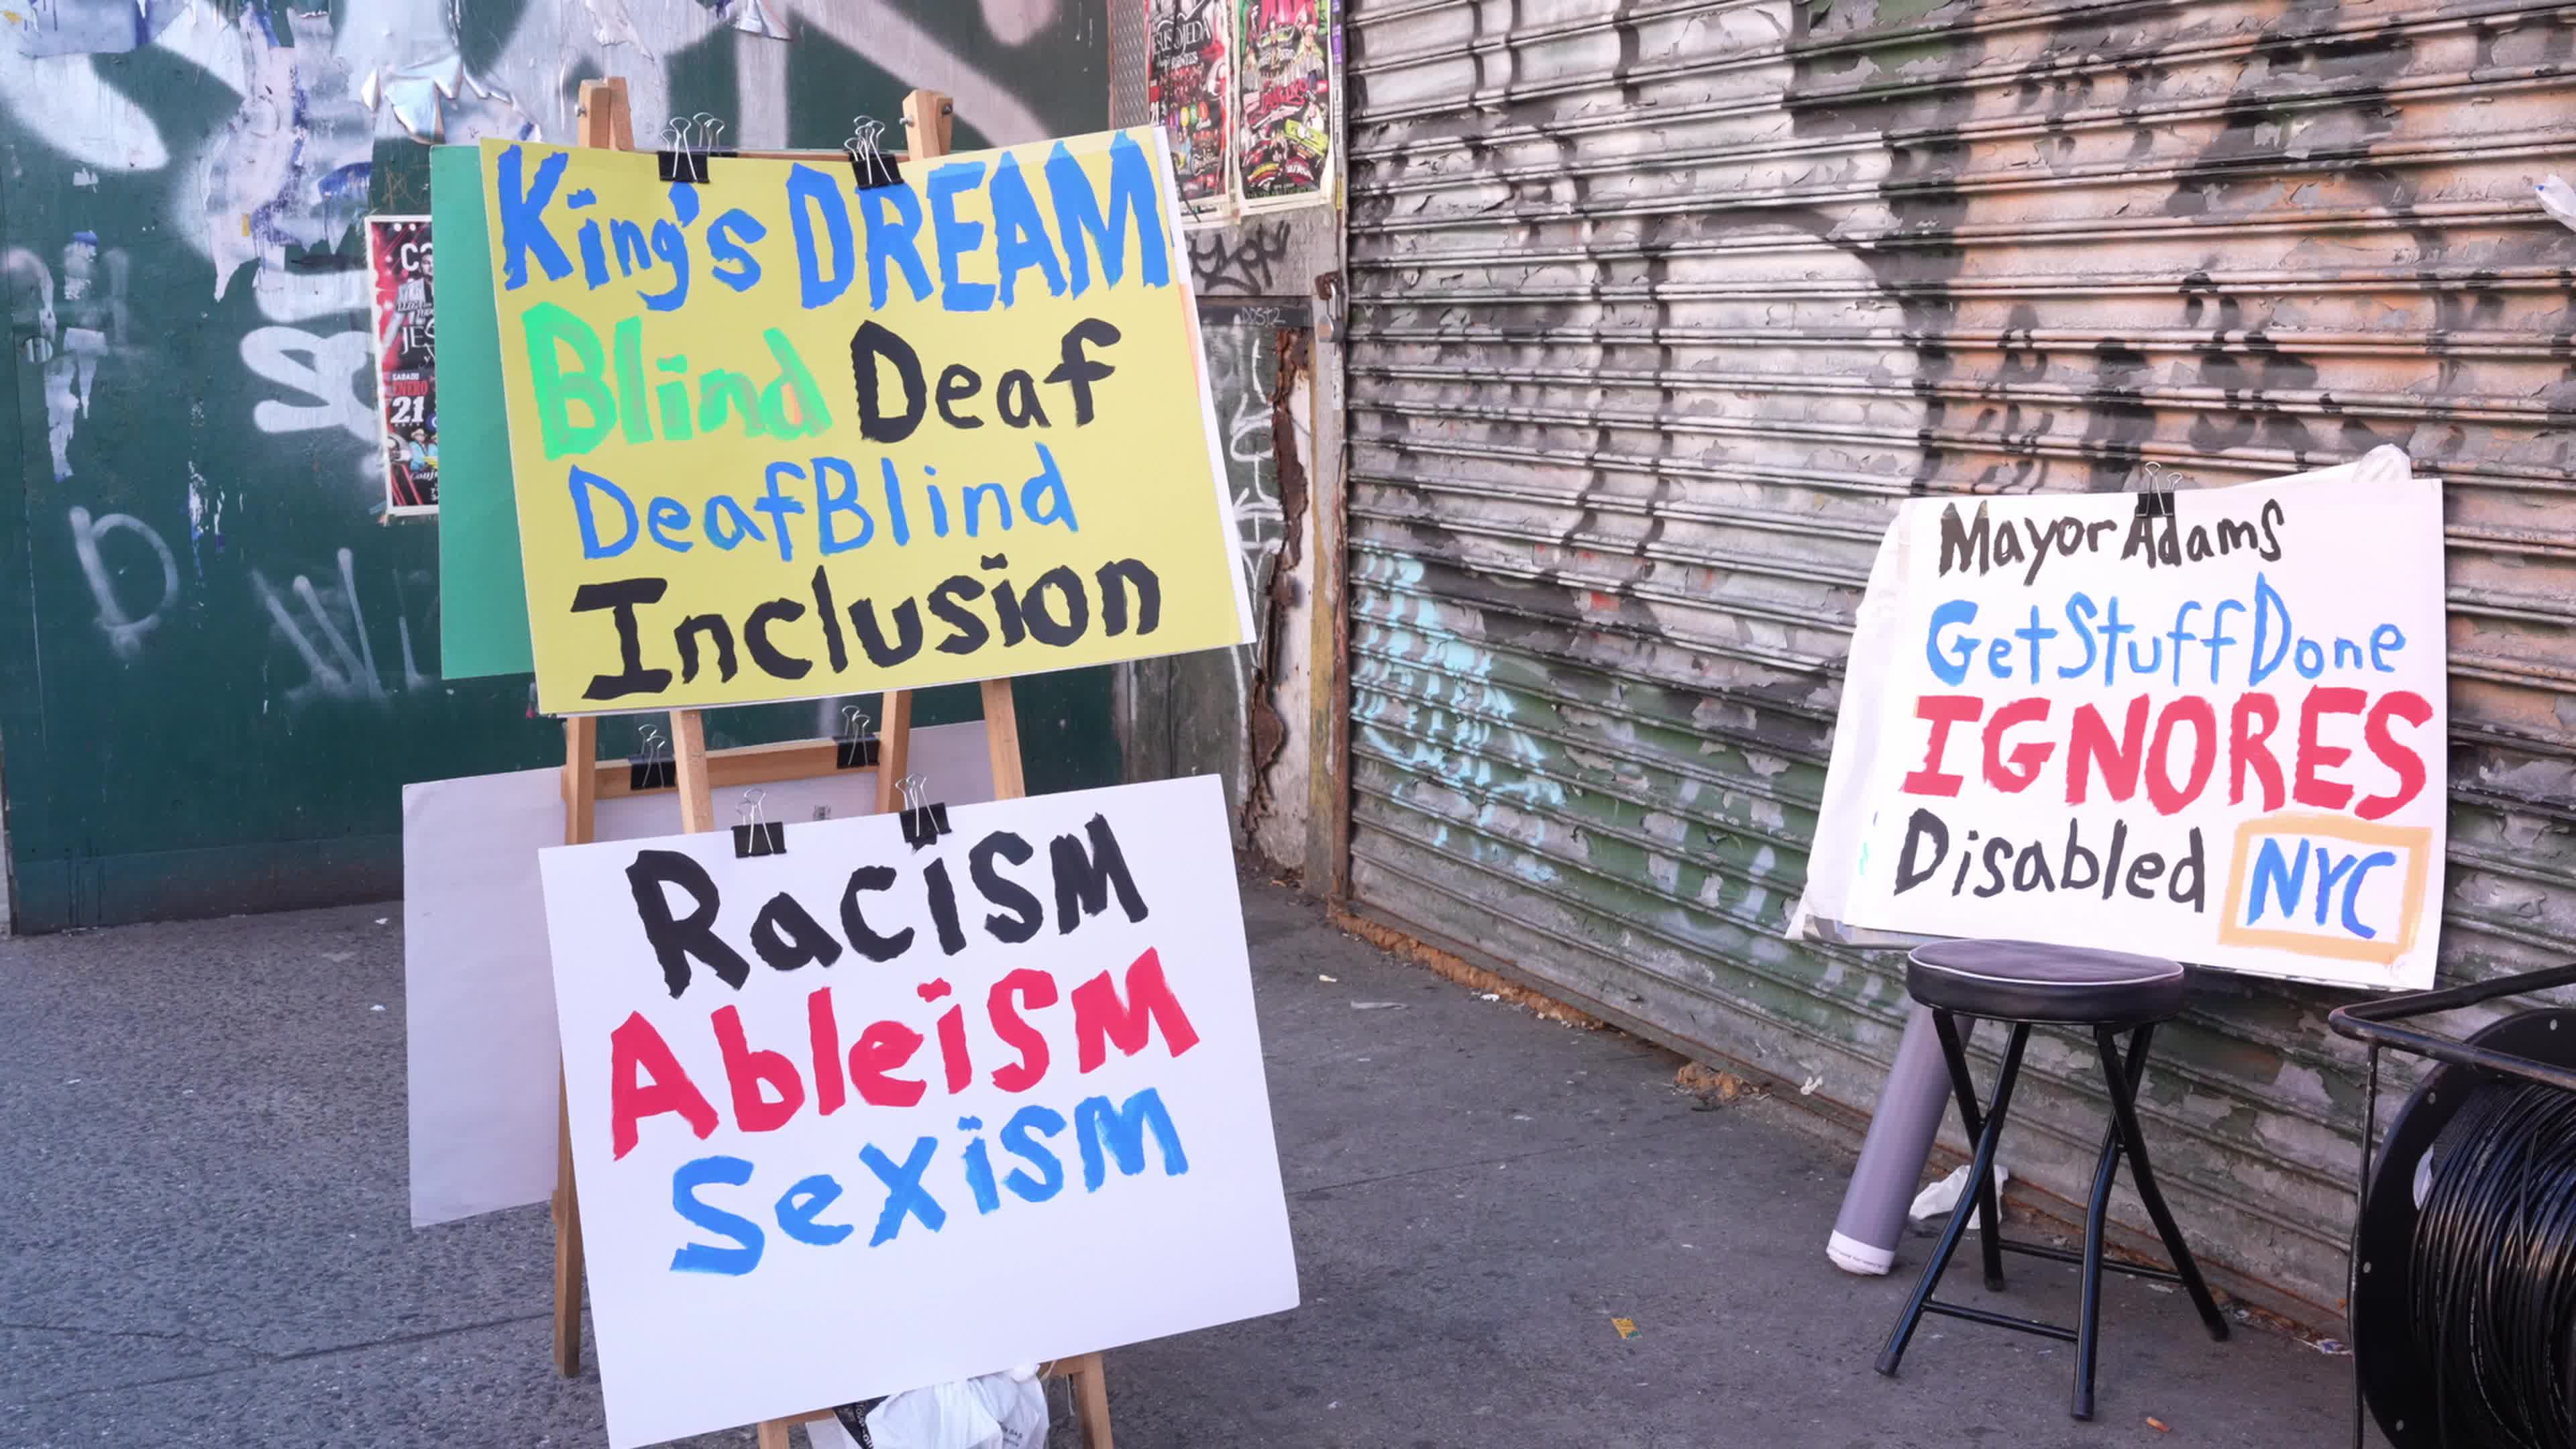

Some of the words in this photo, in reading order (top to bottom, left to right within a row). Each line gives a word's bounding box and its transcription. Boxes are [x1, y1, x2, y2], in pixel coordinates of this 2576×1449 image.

[498, 144, 767, 313] King's
[786, 131, 1171, 313] DREAM
[390, 396, 424, 423] 21
[519, 299, 834, 462] Blind
[849, 317, 1122, 444] Deaf
[568, 442, 1079, 561] DeafBlind
[1939, 500, 2118, 586] Mayor
[2120, 498, 2285, 569] Adams
[570, 554, 1162, 701] Inclusion
[1900, 685, 2434, 821] IGNORES
[1893, 807, 2206, 914] Disabled
[2247, 837, 2397, 939] NYC
